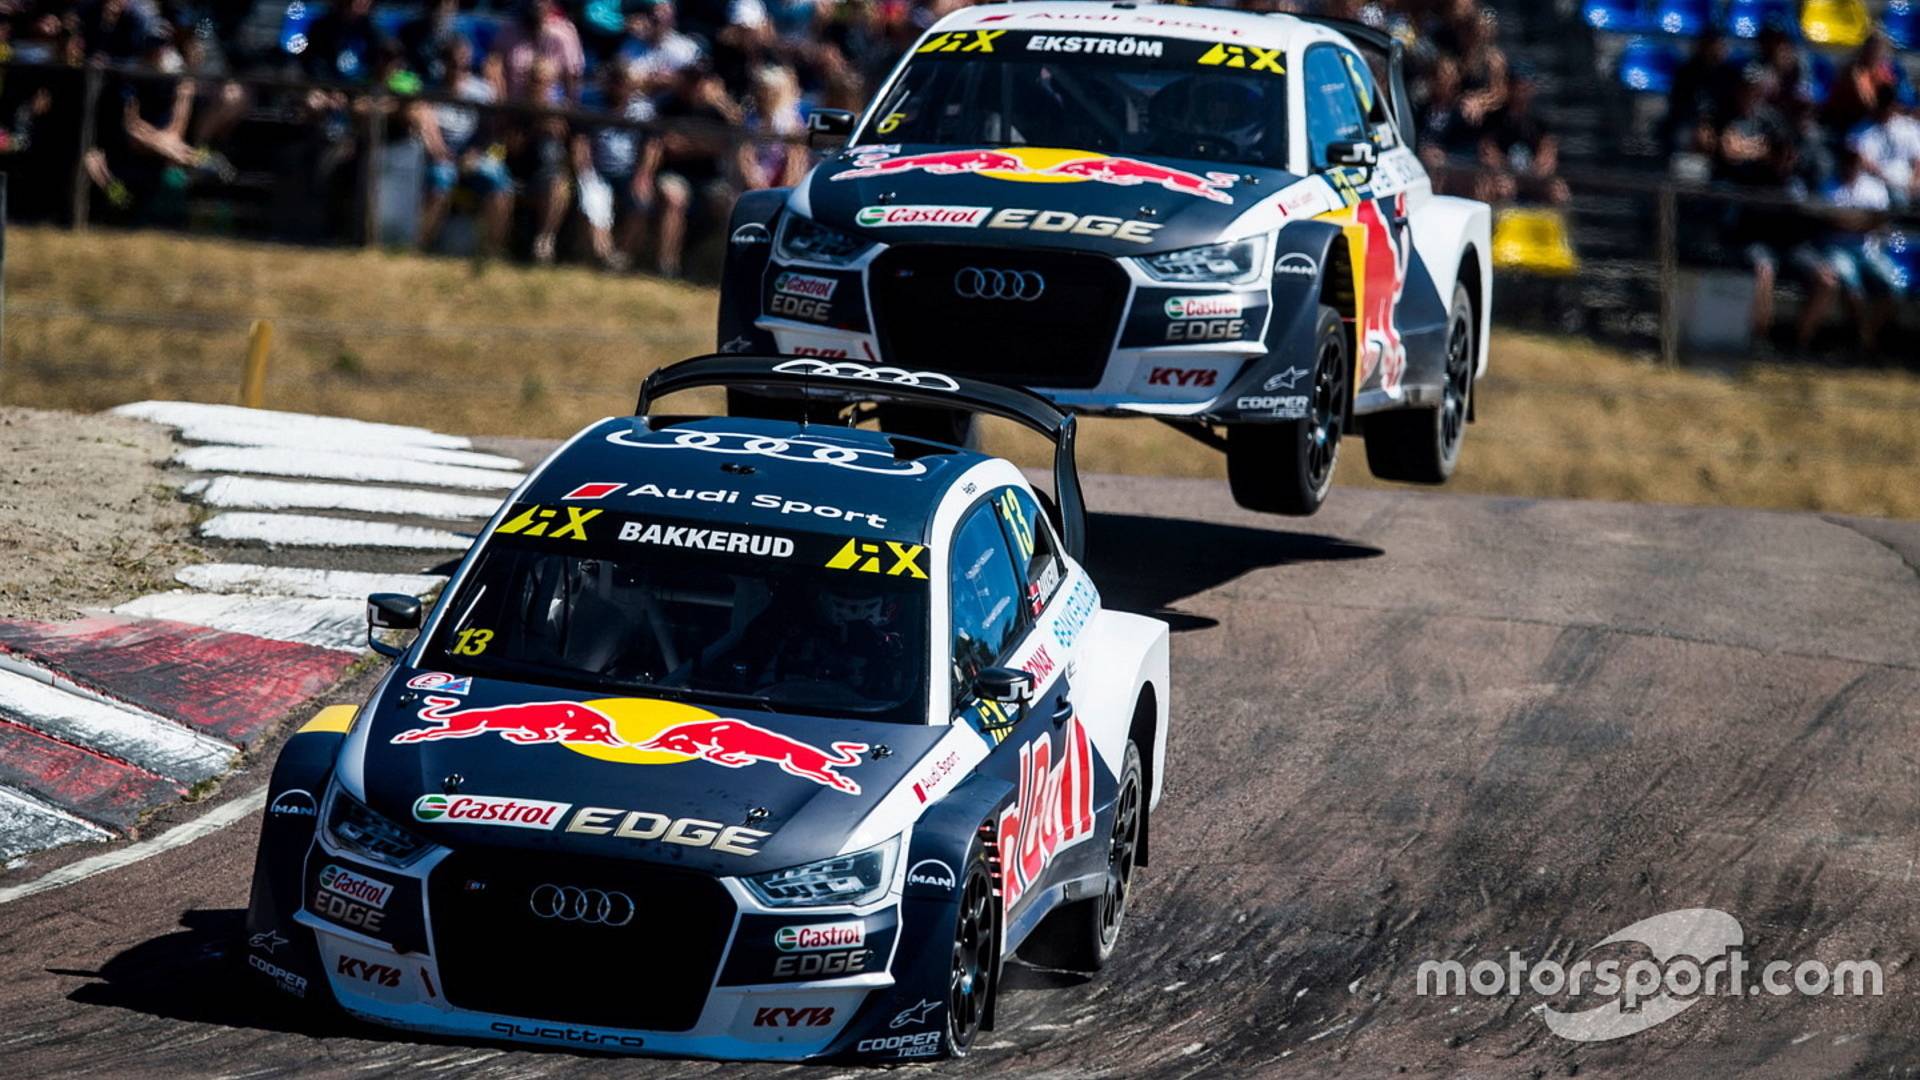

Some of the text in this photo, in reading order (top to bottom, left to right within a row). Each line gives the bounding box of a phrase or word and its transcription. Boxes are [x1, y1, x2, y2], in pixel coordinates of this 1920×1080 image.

[1026, 35, 1163, 58] EKSTRÖM
[887, 207, 1166, 244] Castrol EDGE
[771, 293, 833, 321] EDGE
[1165, 320, 1245, 340] EDGE
[1148, 367, 1217, 387] KYB
[1237, 394, 1309, 410] COOPER
[627, 483, 888, 530] Audi Sport
[1001, 487, 1034, 561] 13
[618, 520, 796, 559] BAKKERUD
[452, 627, 495, 656] 13
[936, 751, 961, 776] Sport
[273, 804, 315, 816] MAN
[447, 797, 773, 857] Castrol EDGE
[332, 871, 389, 906] Castrol
[911, 873, 953, 887] MAN
[313, 890, 387, 932] EDGE
[798, 924, 861, 948] Castrol
[249, 953, 309, 990] COOPER
[337, 954, 403, 988] KYB
[773, 949, 869, 977] EDGE
[753, 1007, 836, 1027] KYB
[490, 1021, 645, 1048] quattro
[857, 1031, 942, 1052] COOPER
[897, 1043, 938, 1057] TIRES
